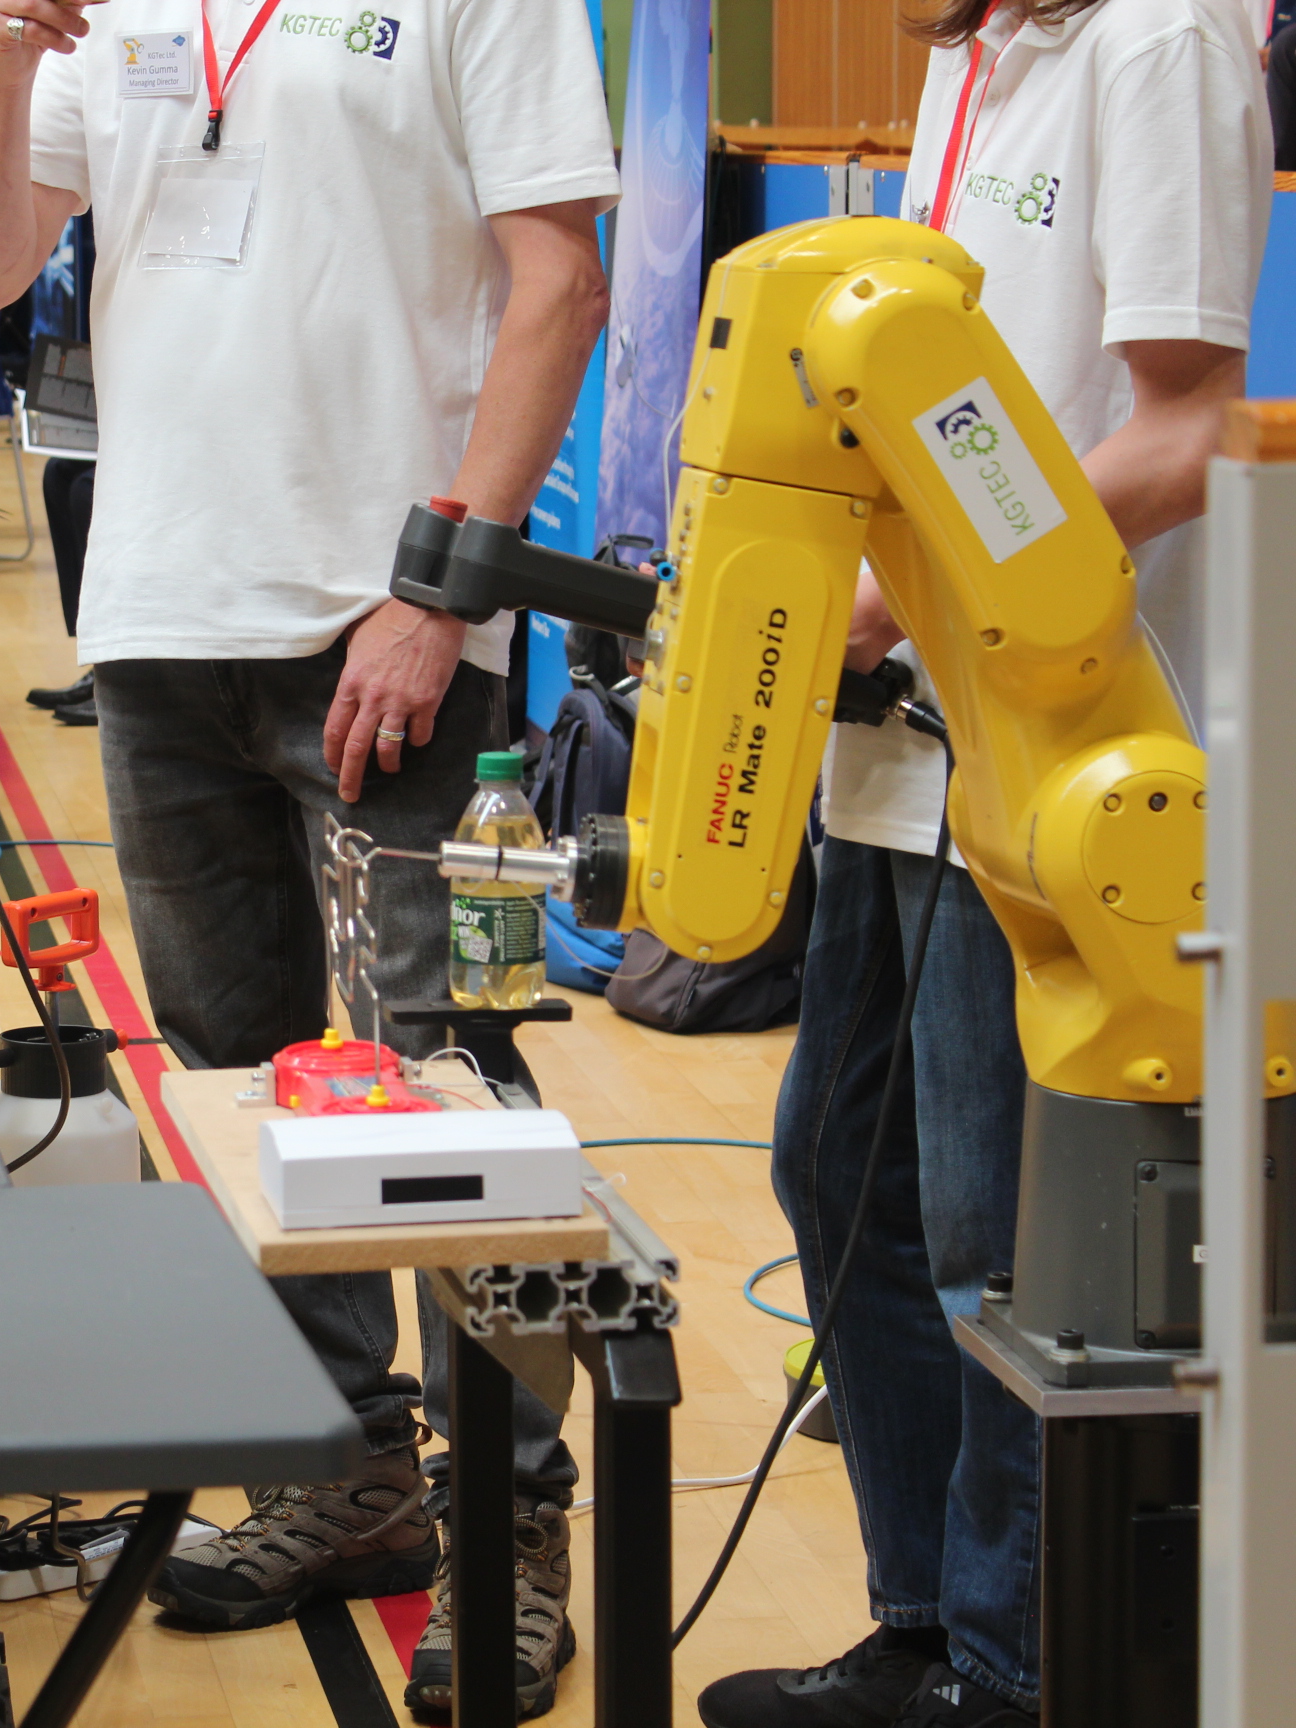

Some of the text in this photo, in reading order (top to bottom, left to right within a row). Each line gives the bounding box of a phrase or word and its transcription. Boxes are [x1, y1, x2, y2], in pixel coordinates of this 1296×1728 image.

[279, 13, 343, 37] KGTEC
[127, 65, 178, 75] Kevin Gumma
[148, 51, 177, 60] KGTec Ltd.
[129, 78, 179, 88] Managing Director
[965, 172, 1014, 206] KGTEC
[979, 460, 1035, 536] KGTEC
[728, 608, 787, 848] LR Mate 200iD
[706, 763, 734, 844] FANUC
